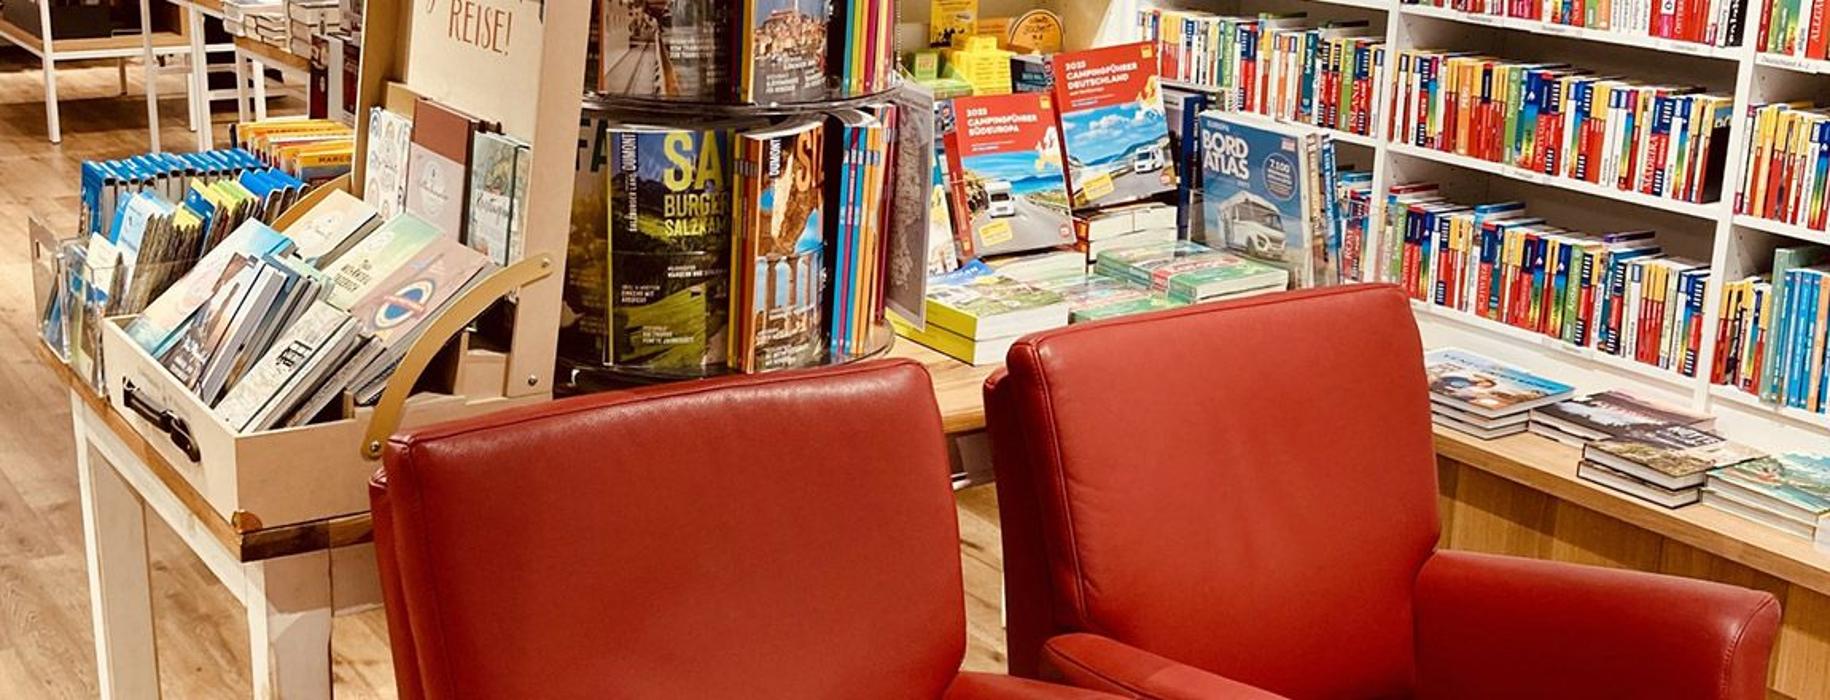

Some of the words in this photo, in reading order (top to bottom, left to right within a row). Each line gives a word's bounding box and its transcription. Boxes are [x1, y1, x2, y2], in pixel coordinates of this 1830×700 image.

[448, 0, 512, 56] REISE!
[1066, 62, 1138, 81] CAMPINGFÜHRER
[1067, 73, 1129, 90] DEUTSCHLAND
[1350, 82, 1360, 130] ISLAND
[968, 124, 1019, 137] SÜDEUROPA
[1202, 129, 1249, 159] BORD
[621, 133, 637, 171] DUMONT
[769, 139, 781, 177] DUMONT
[1203, 150, 1250, 181] ATLAS
